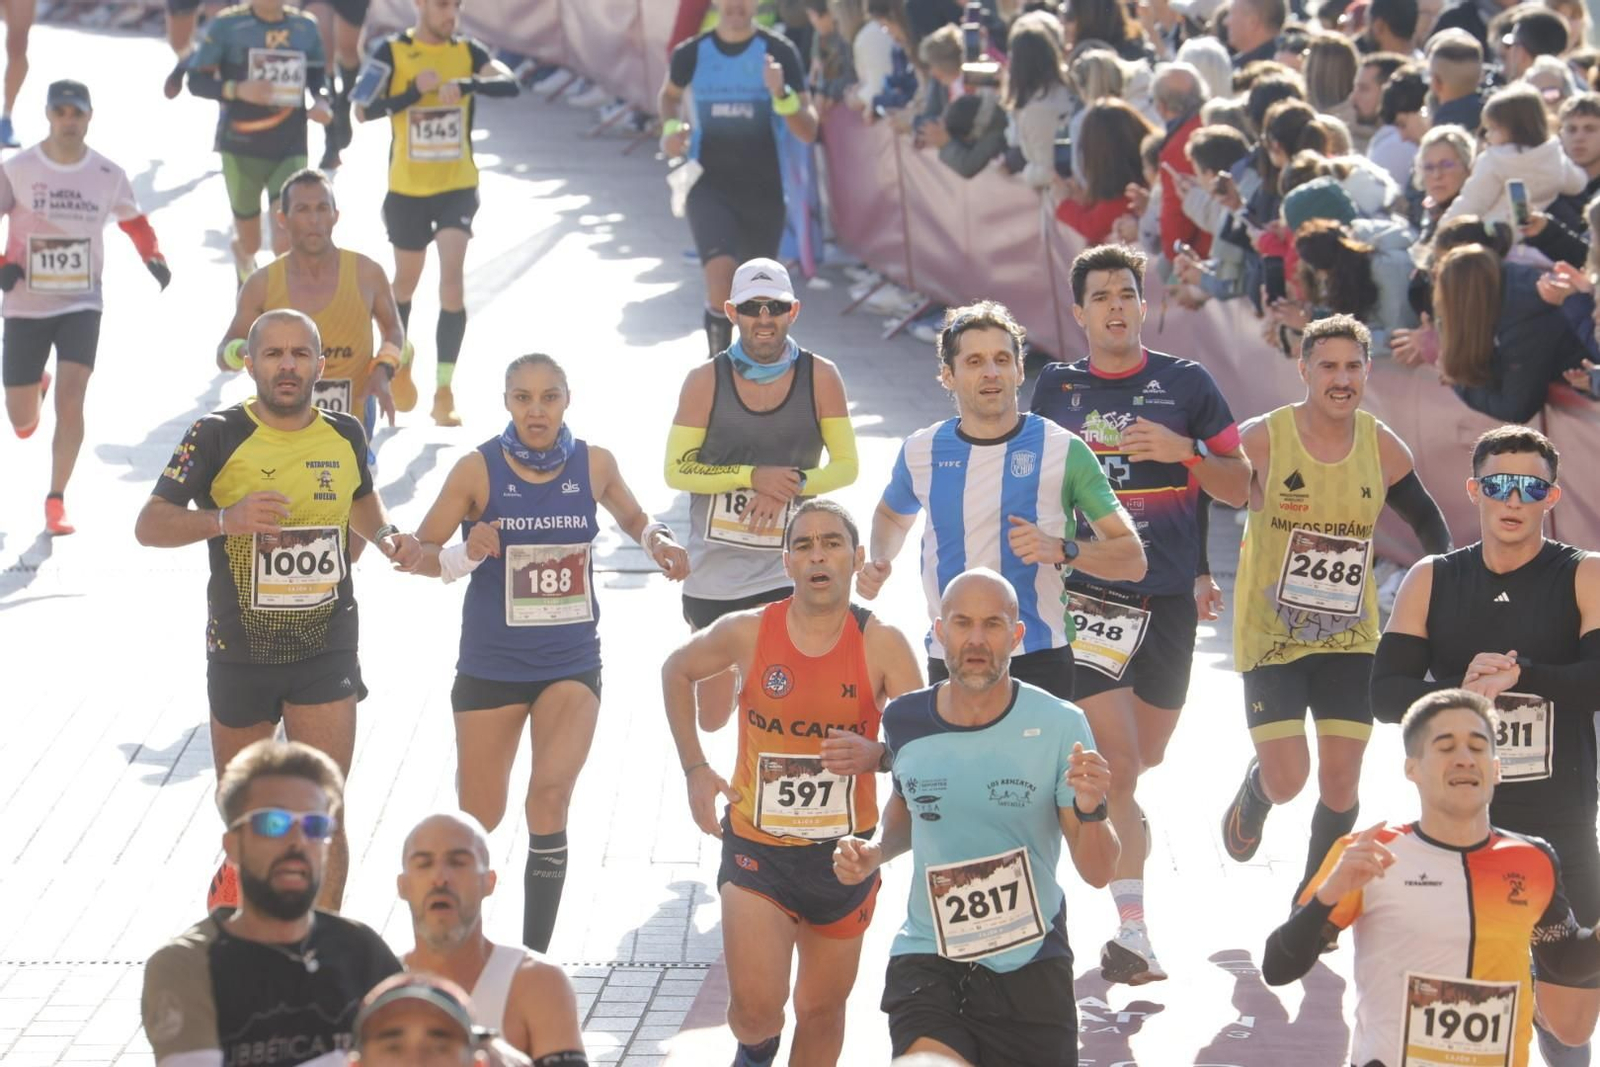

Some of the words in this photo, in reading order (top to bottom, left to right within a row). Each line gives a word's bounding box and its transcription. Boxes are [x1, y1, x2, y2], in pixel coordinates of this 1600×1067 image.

[413, 122, 458, 139] 1545
[40, 253, 82, 270] 1193
[313, 492, 337, 501] HUELVA
[1279, 502, 1309, 512] valora
[498, 515, 588, 530] TROTASIERRA
[263, 551, 335, 576] 1006
[1290, 554, 1363, 586] 2688
[528, 567, 573, 594] 188
[748, 709, 784, 735] CDA
[777, 780, 834, 807] 597
[945, 881, 1018, 924] 2817
[1424, 1007, 1501, 1043] 1901
